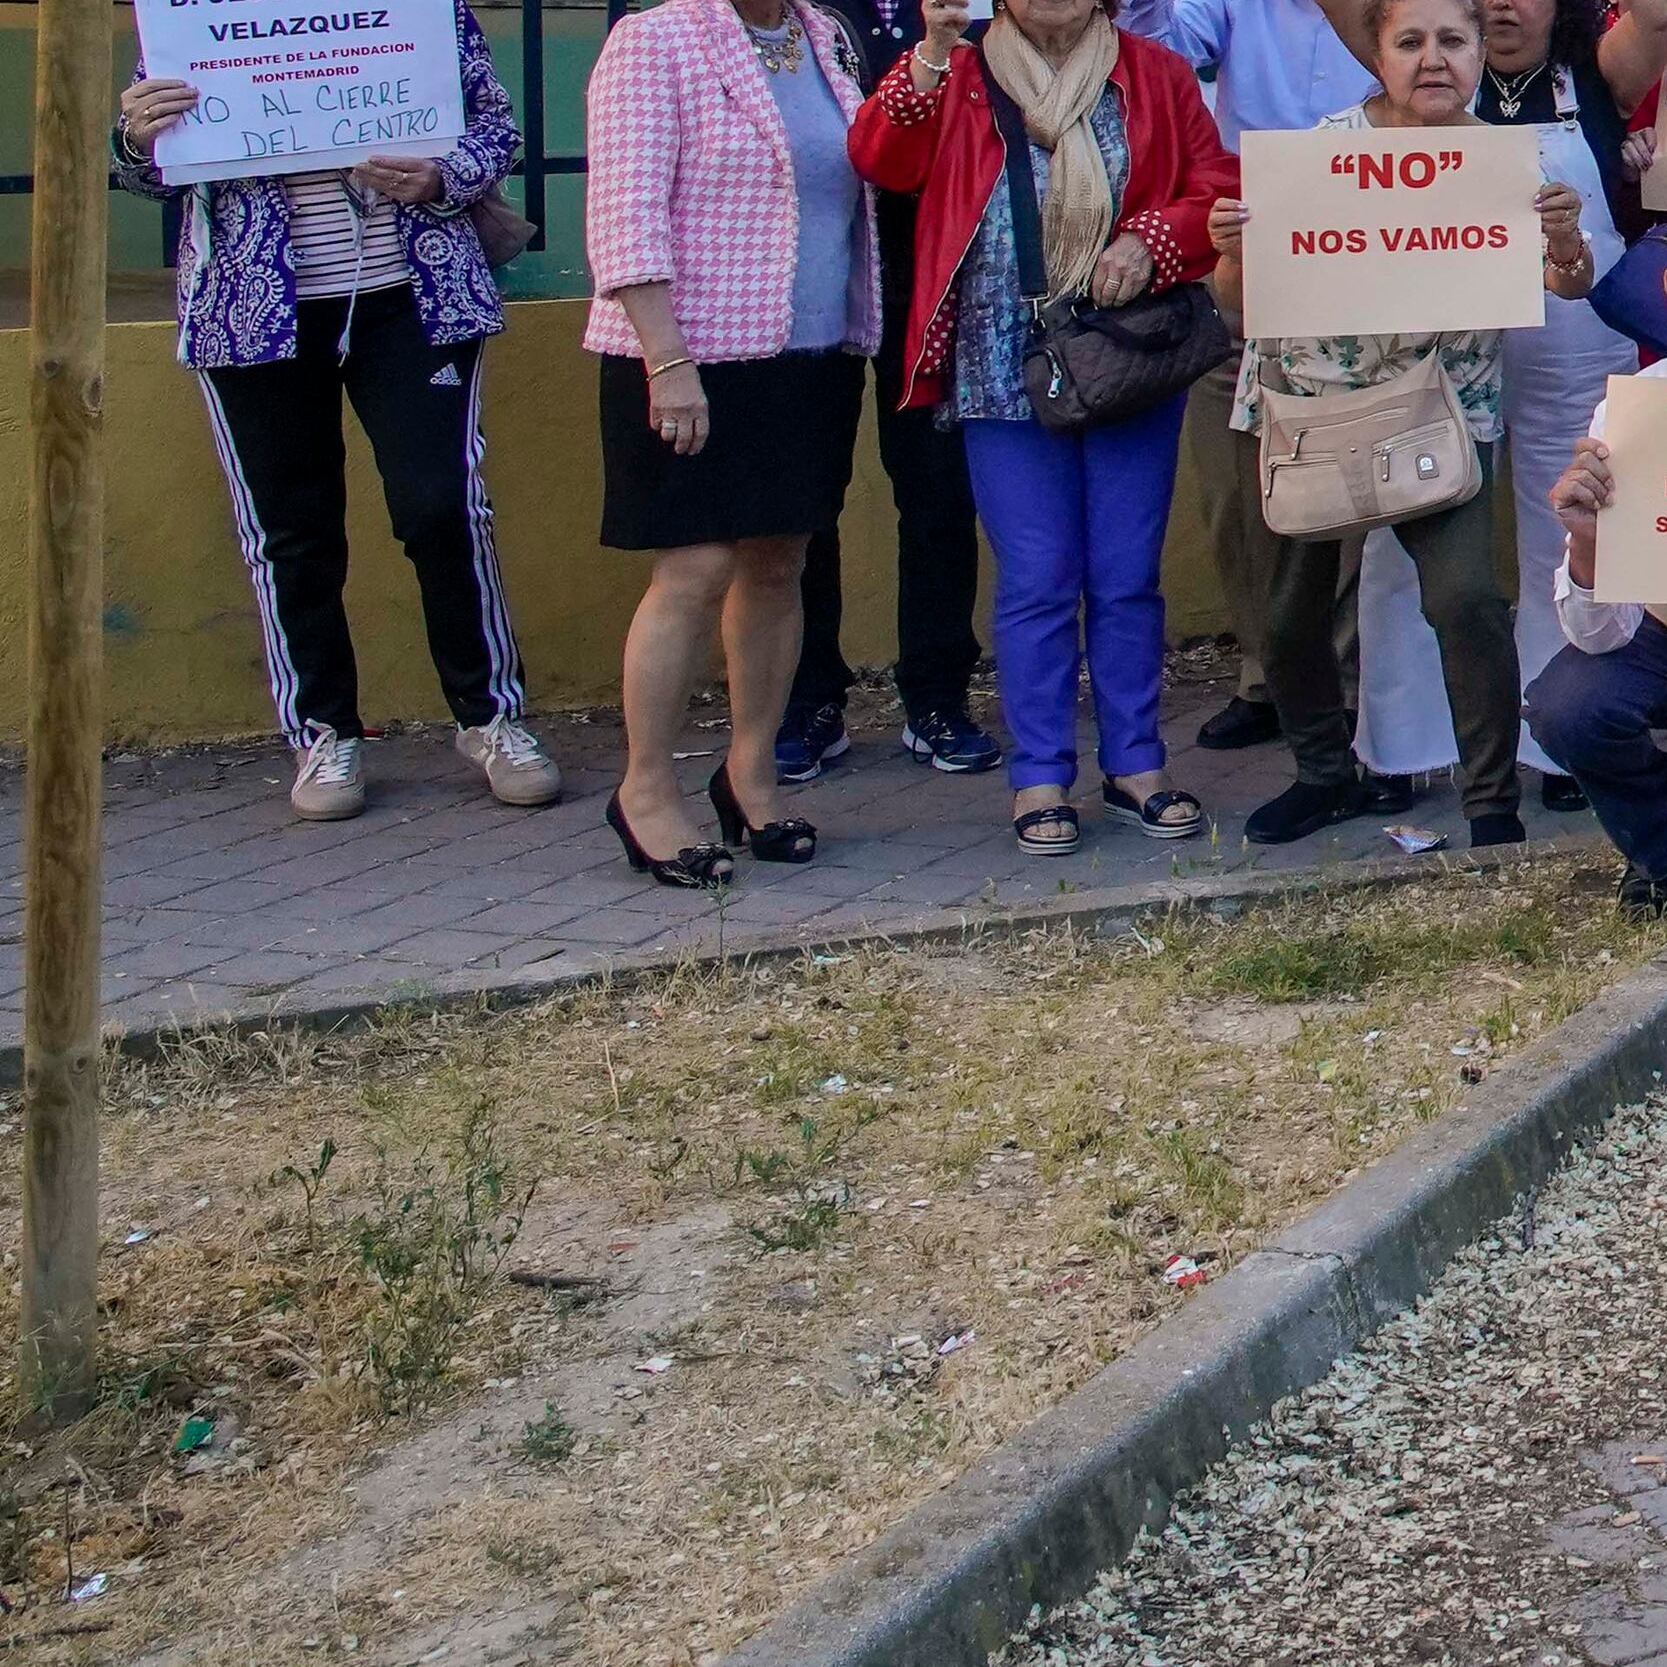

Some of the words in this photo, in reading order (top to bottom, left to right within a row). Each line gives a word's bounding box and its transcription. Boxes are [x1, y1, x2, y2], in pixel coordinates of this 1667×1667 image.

[208, 10, 389, 41] VELAZQUEZ
[190, 55, 281, 70] PRESIDENTE
[286, 53, 304, 62] DE
[309, 48, 328, 59] LA
[332, 43, 414, 58] FUNDACION
[253, 66, 359, 83] MONTEMADRID
[262, 89, 302, 117] AL
[316, 78, 410, 111] CIERRE
[241, 126, 308, 157] DEL
[332, 107, 445, 146] CENTRO
[1292, 230, 1367, 254] NOS
[1379, 225, 1508, 251] VAMOS
